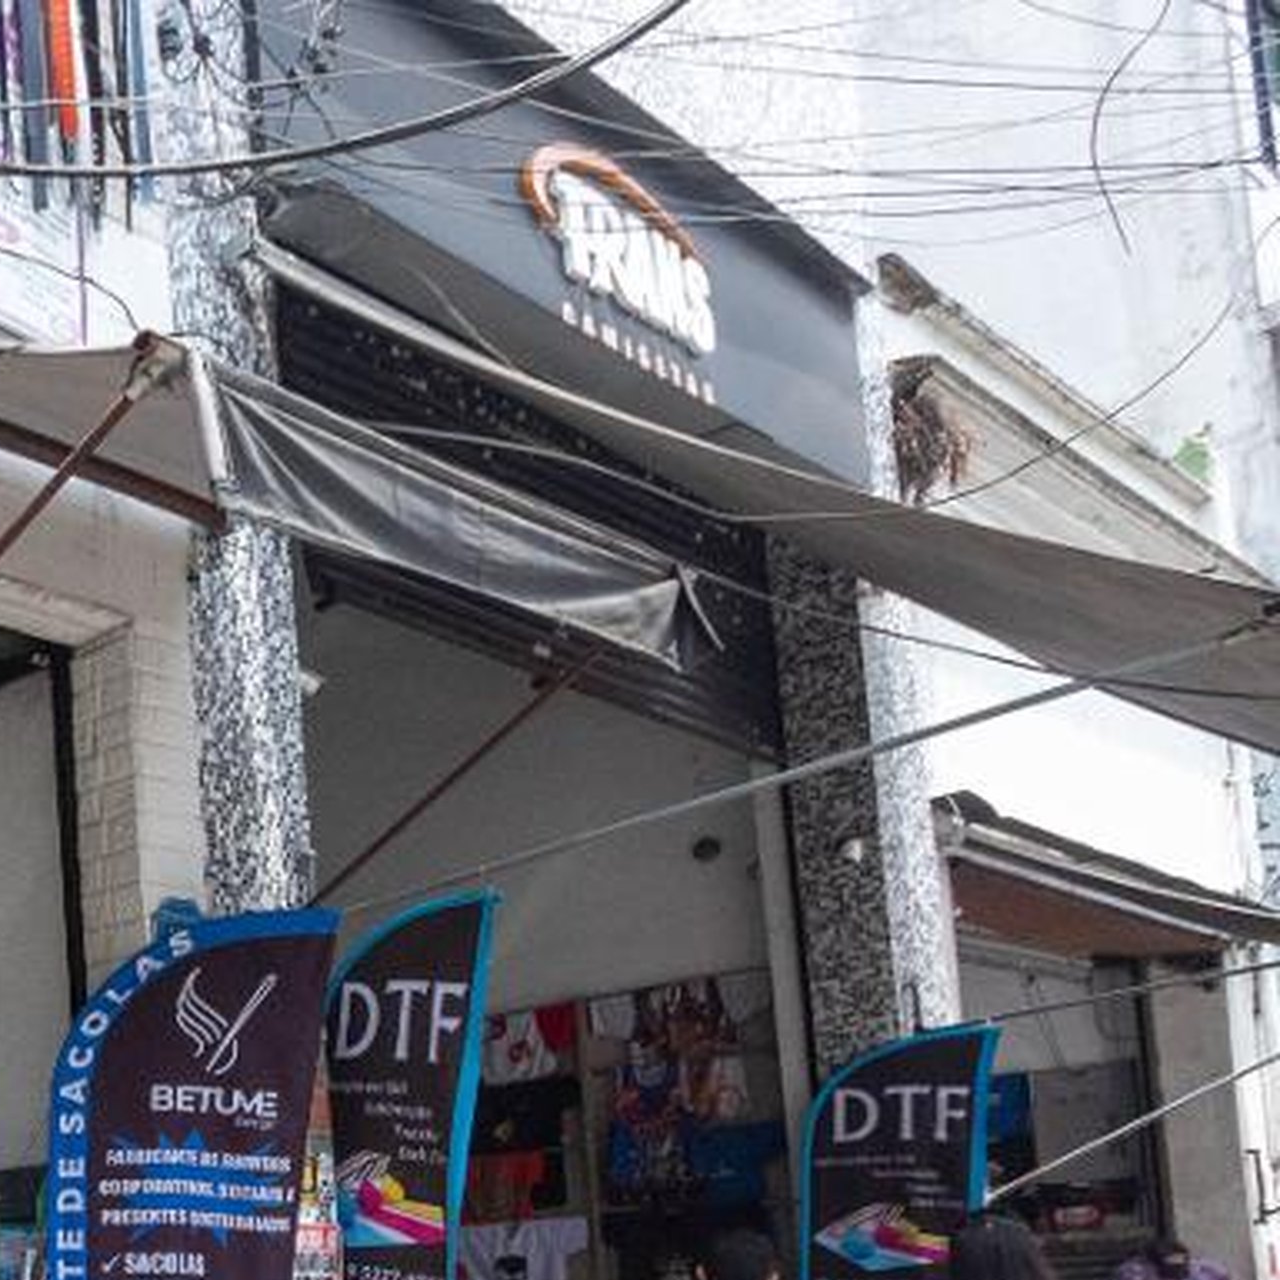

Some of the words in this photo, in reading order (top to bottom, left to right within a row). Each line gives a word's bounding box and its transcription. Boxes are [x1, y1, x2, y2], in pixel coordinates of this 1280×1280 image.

[59, 930, 193, 1134] SACOLAS
[336, 979, 469, 1064] DTF
[149, 1083, 278, 1119] BETUME
[832, 1084, 970, 1143] DTF
[56, 1157, 85, 1213] DE
[123, 1253, 206, 1276] SACOLAS
